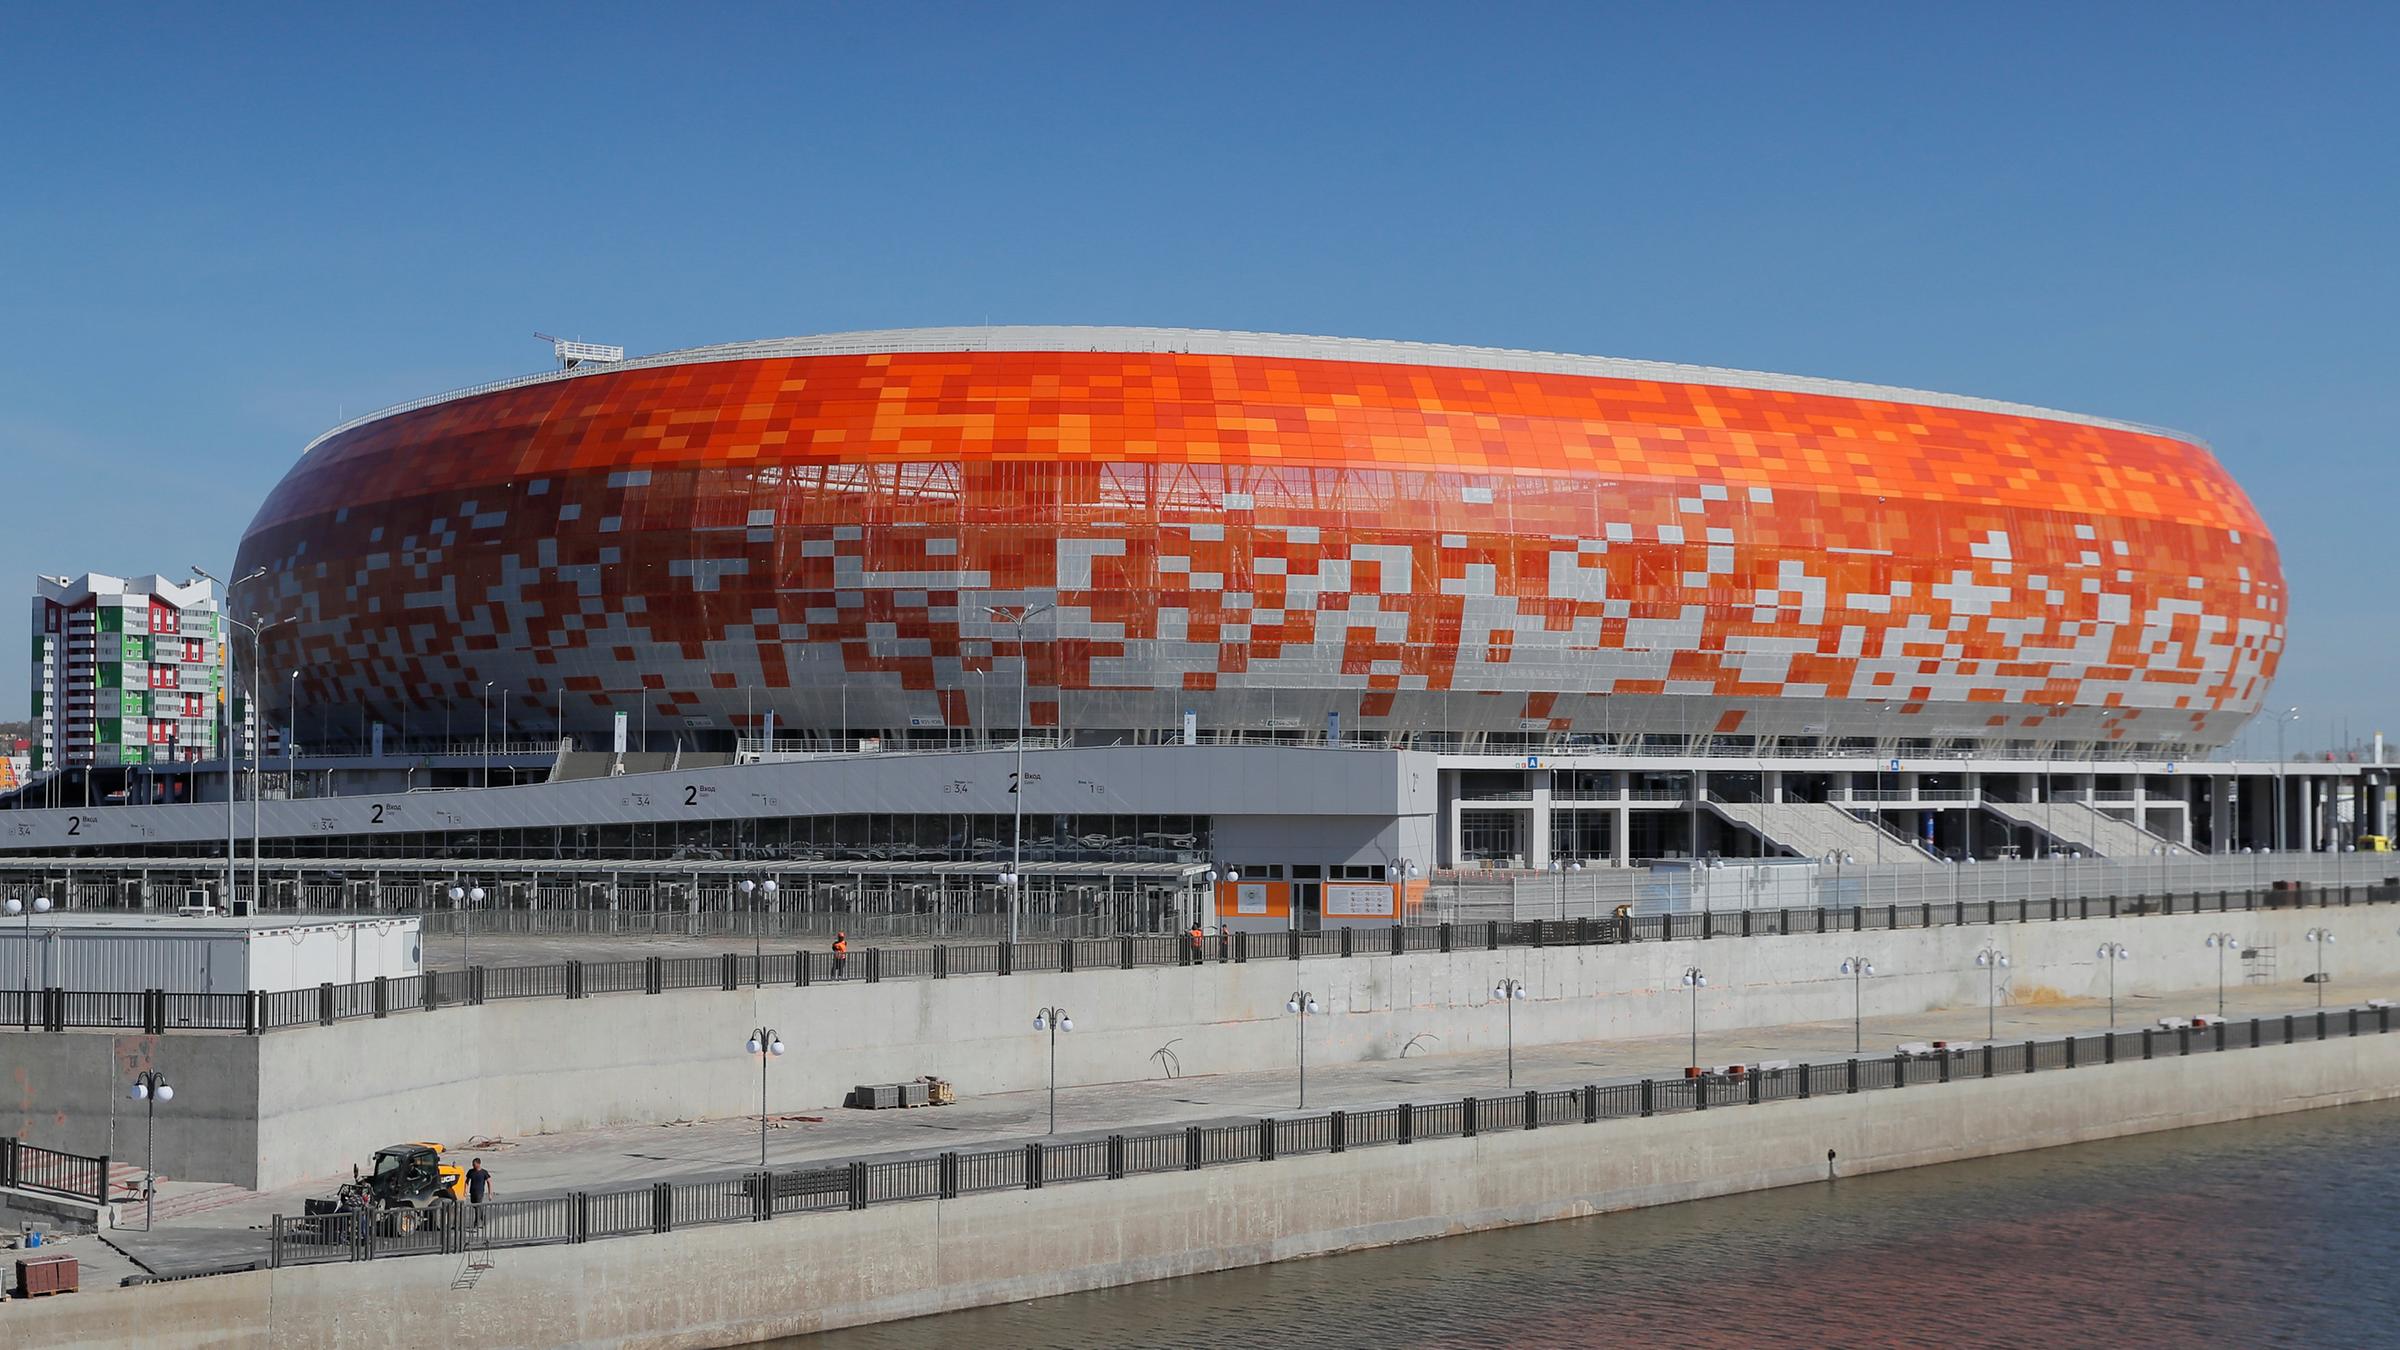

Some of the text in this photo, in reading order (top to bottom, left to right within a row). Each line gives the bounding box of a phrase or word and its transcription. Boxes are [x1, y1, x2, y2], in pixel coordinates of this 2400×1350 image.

[1024, 772, 1041, 780] Вход
[954, 784, 968, 794] 3,4
[684, 785, 716, 806] 2 Вход
[637, 796, 650, 807] 3,4
[371, 803, 402, 823] 2 Вход
[68, 816, 98, 835] 2 Вход
[18, 826, 31, 837] 3,4
[441, 1175, 456, 1183] JCB
